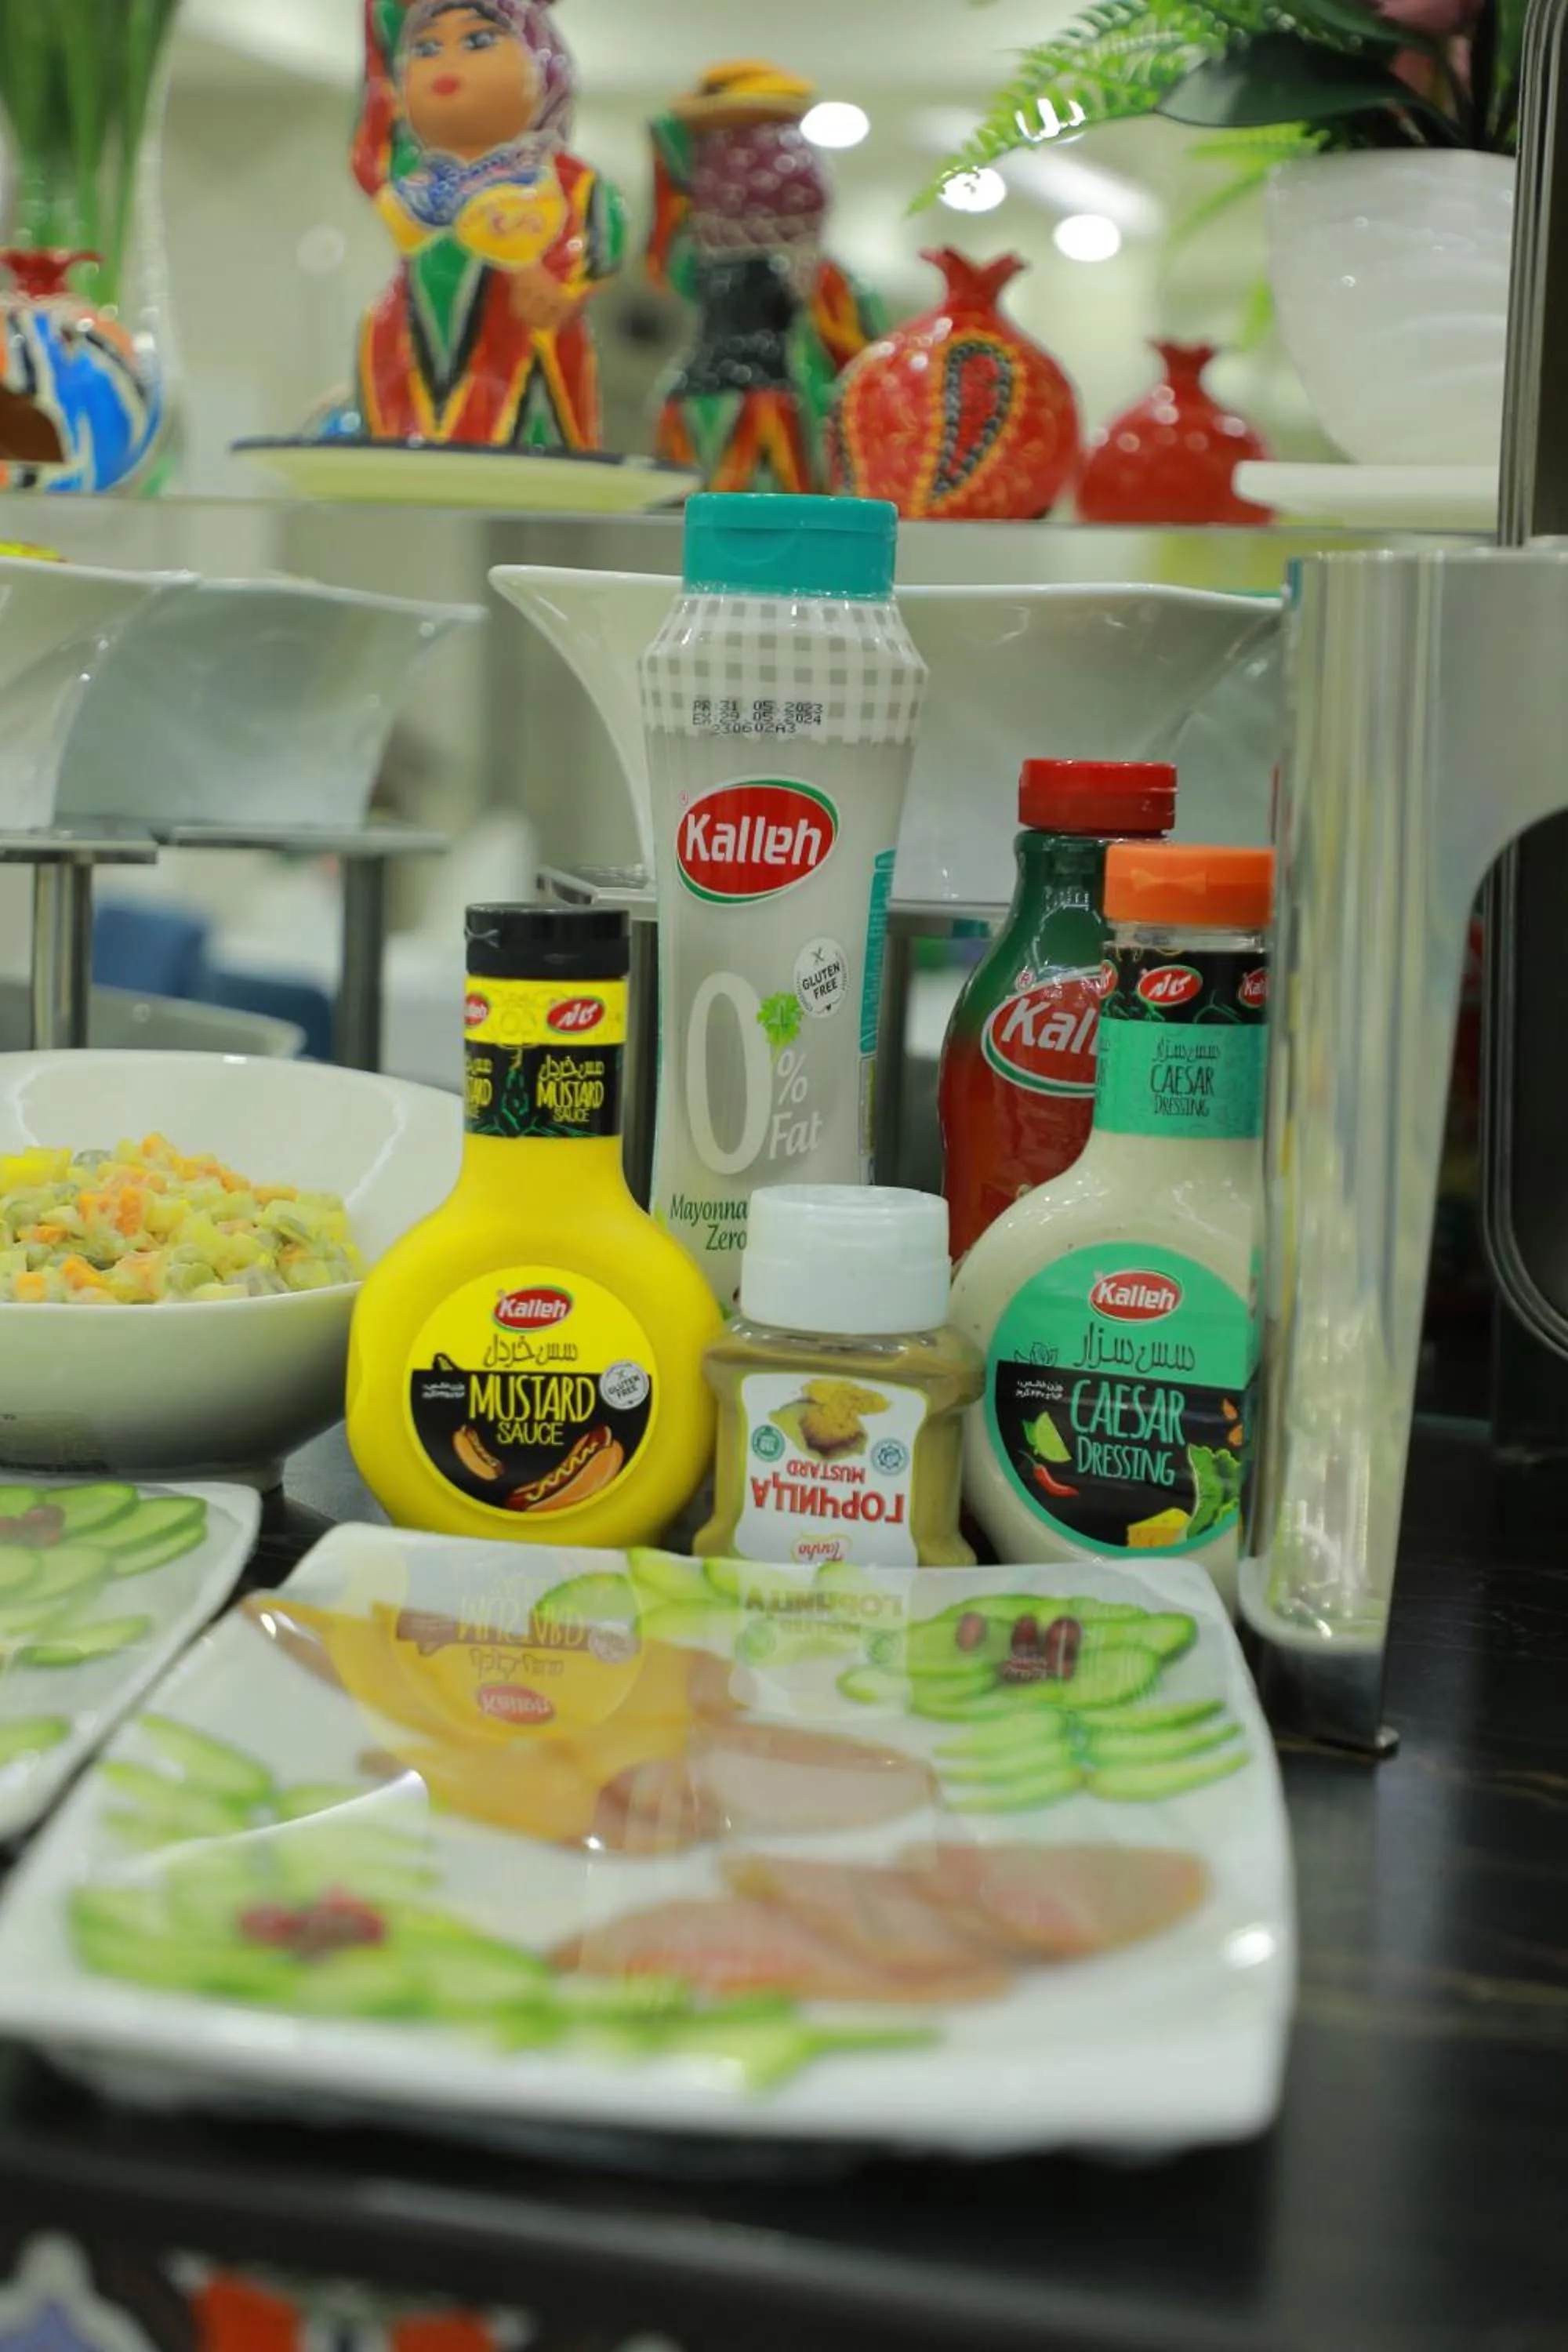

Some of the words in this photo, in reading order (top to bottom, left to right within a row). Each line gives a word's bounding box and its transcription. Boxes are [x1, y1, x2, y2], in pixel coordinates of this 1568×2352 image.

[686, 813, 822, 866] Kalleh
[802, 960, 840, 990] GLUTEN
[813, 978, 838, 1000] FREE
[536, 1080, 604, 1109] MUSTARD
[1151, 1065, 1215, 1097] CAESAR
[554, 1108, 590, 1122] SAUCE
[1154, 1094, 1210, 1116] DRESSING
[768, 1111, 823, 1160] Fat
[670, 1192, 747, 1228] Mayonna
[706, 1224, 747, 1250] Zero
[498, 1298, 567, 1320] Kalleh
[1098, 1282, 1175, 1310] Kalleh
[483, 1333, 535, 1368] خردل
[535, 1342, 579, 1367] سس
[1073, 1322, 1134, 1369] سزار
[1135, 1341, 1196, 1373] سس
[470, 1374, 596, 1423] MUSTARD
[1069, 1379, 1185, 1446] CAESAR
[497, 1421, 564, 1445] SAUCE
[786, 1459, 866, 1484] MUSTARD
[1077, 1436, 1175, 1486] DRESSING
[750, 1472, 905, 1524] ГОРЧИЦА
